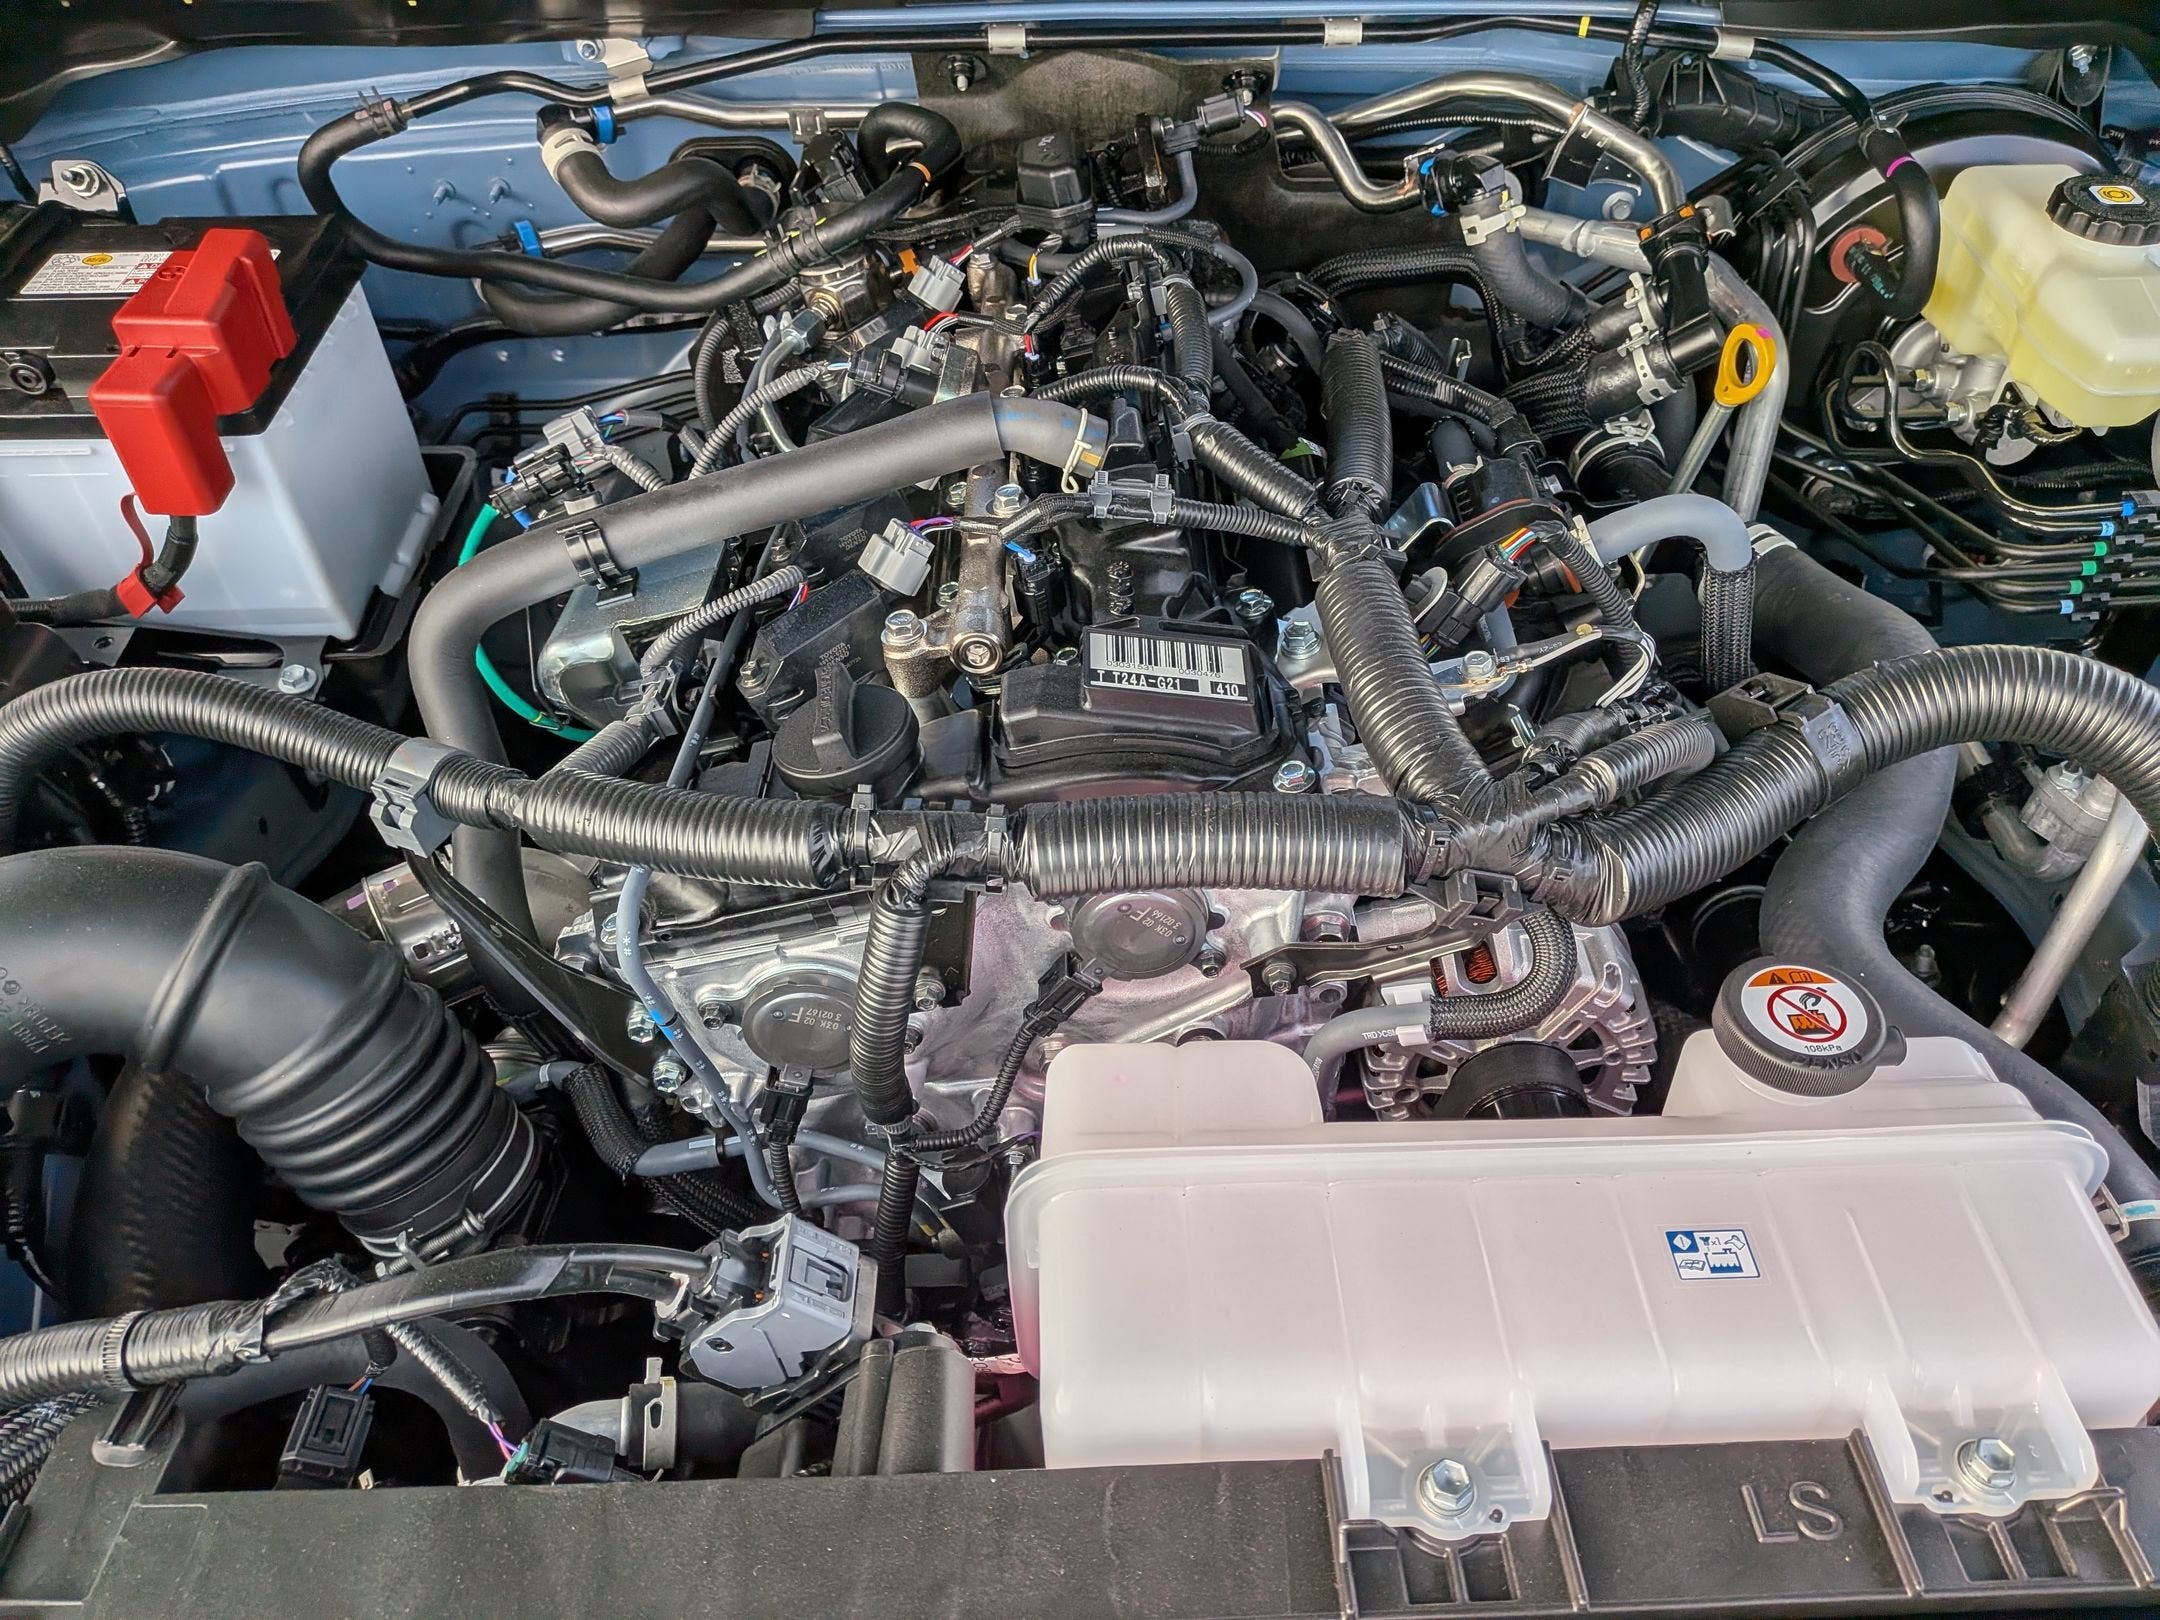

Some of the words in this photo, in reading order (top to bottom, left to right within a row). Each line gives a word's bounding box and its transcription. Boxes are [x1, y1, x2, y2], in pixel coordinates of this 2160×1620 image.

[839, 527, 864, 542] TOYOTA
[819, 642, 846, 660] TOYOTA
[1106, 660, 1154, 671] 03031531
[1178, 668, 1221, 679] 0030476
[1097, 670, 1105, 682] T
[1113, 672, 1181, 690] T24A-G21
[1216, 684, 1239, 696] 410
[1129, 906, 1152, 922] F
[1142, 916, 1154, 927] 02
[788, 1006, 804, 1023] F
[803, 1016, 816, 1025] 02
[1804, 1044, 1843, 1054] 108kPa
[1791, 1051, 1863, 1071] DENSO
[1741, 1480, 1844, 1544] LS
